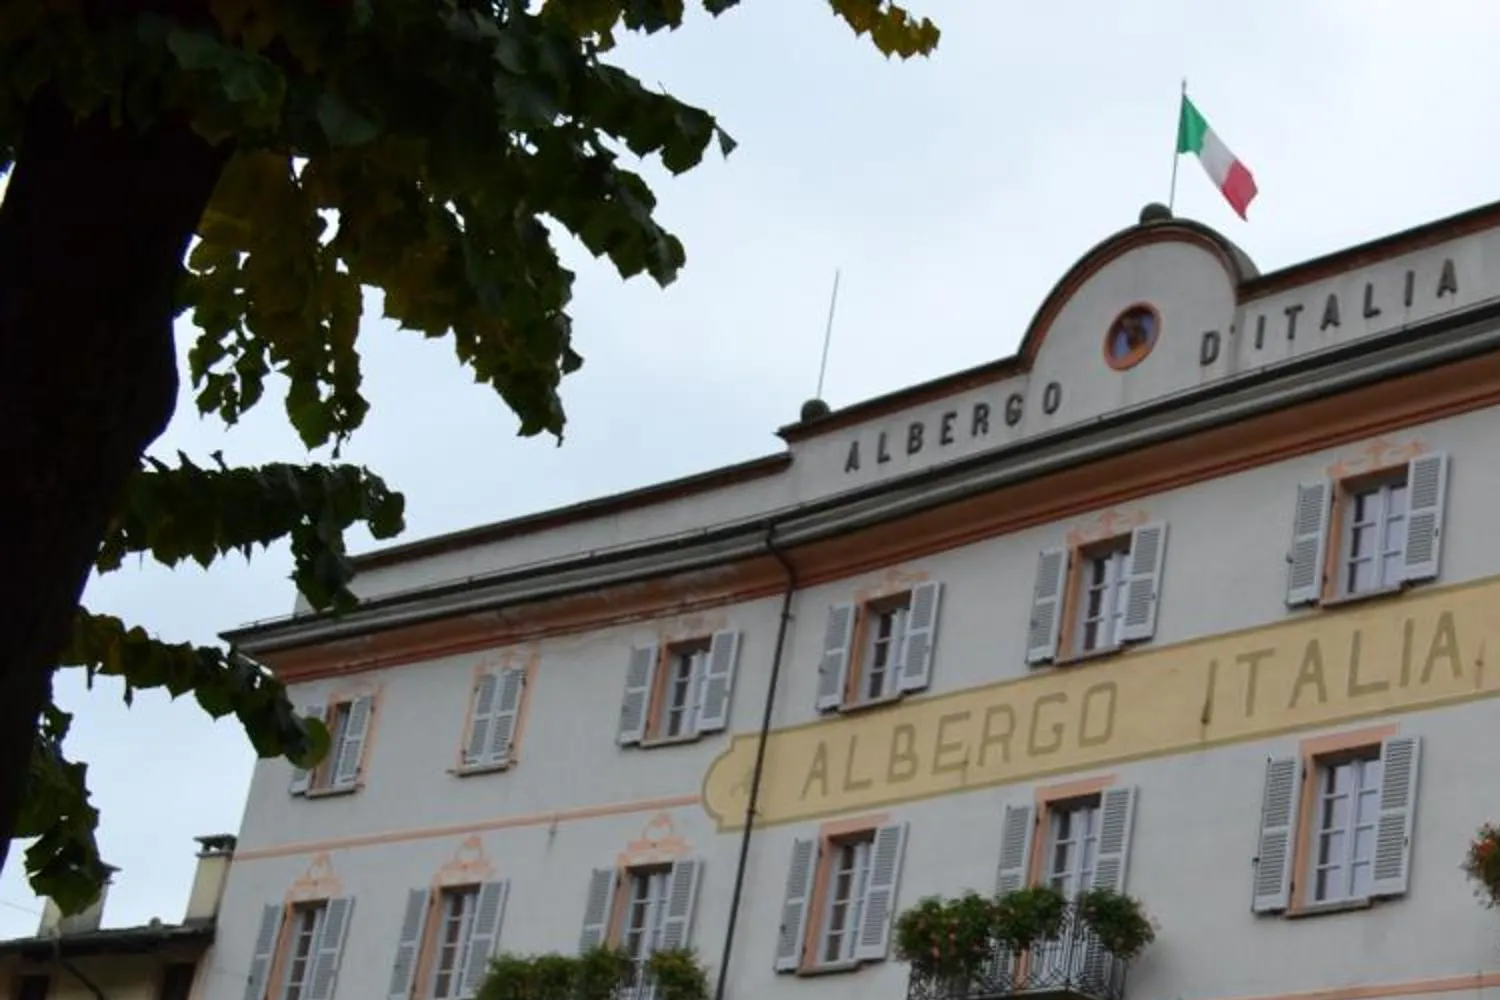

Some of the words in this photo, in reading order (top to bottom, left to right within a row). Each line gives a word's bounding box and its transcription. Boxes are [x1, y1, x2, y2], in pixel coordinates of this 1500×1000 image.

[844, 381, 1062, 473] ALBERGO
[1199, 257, 1458, 366] D'ITALIA
[801, 681, 1118, 800] ALBERGO
[1201, 610, 1464, 724] ITALIA
